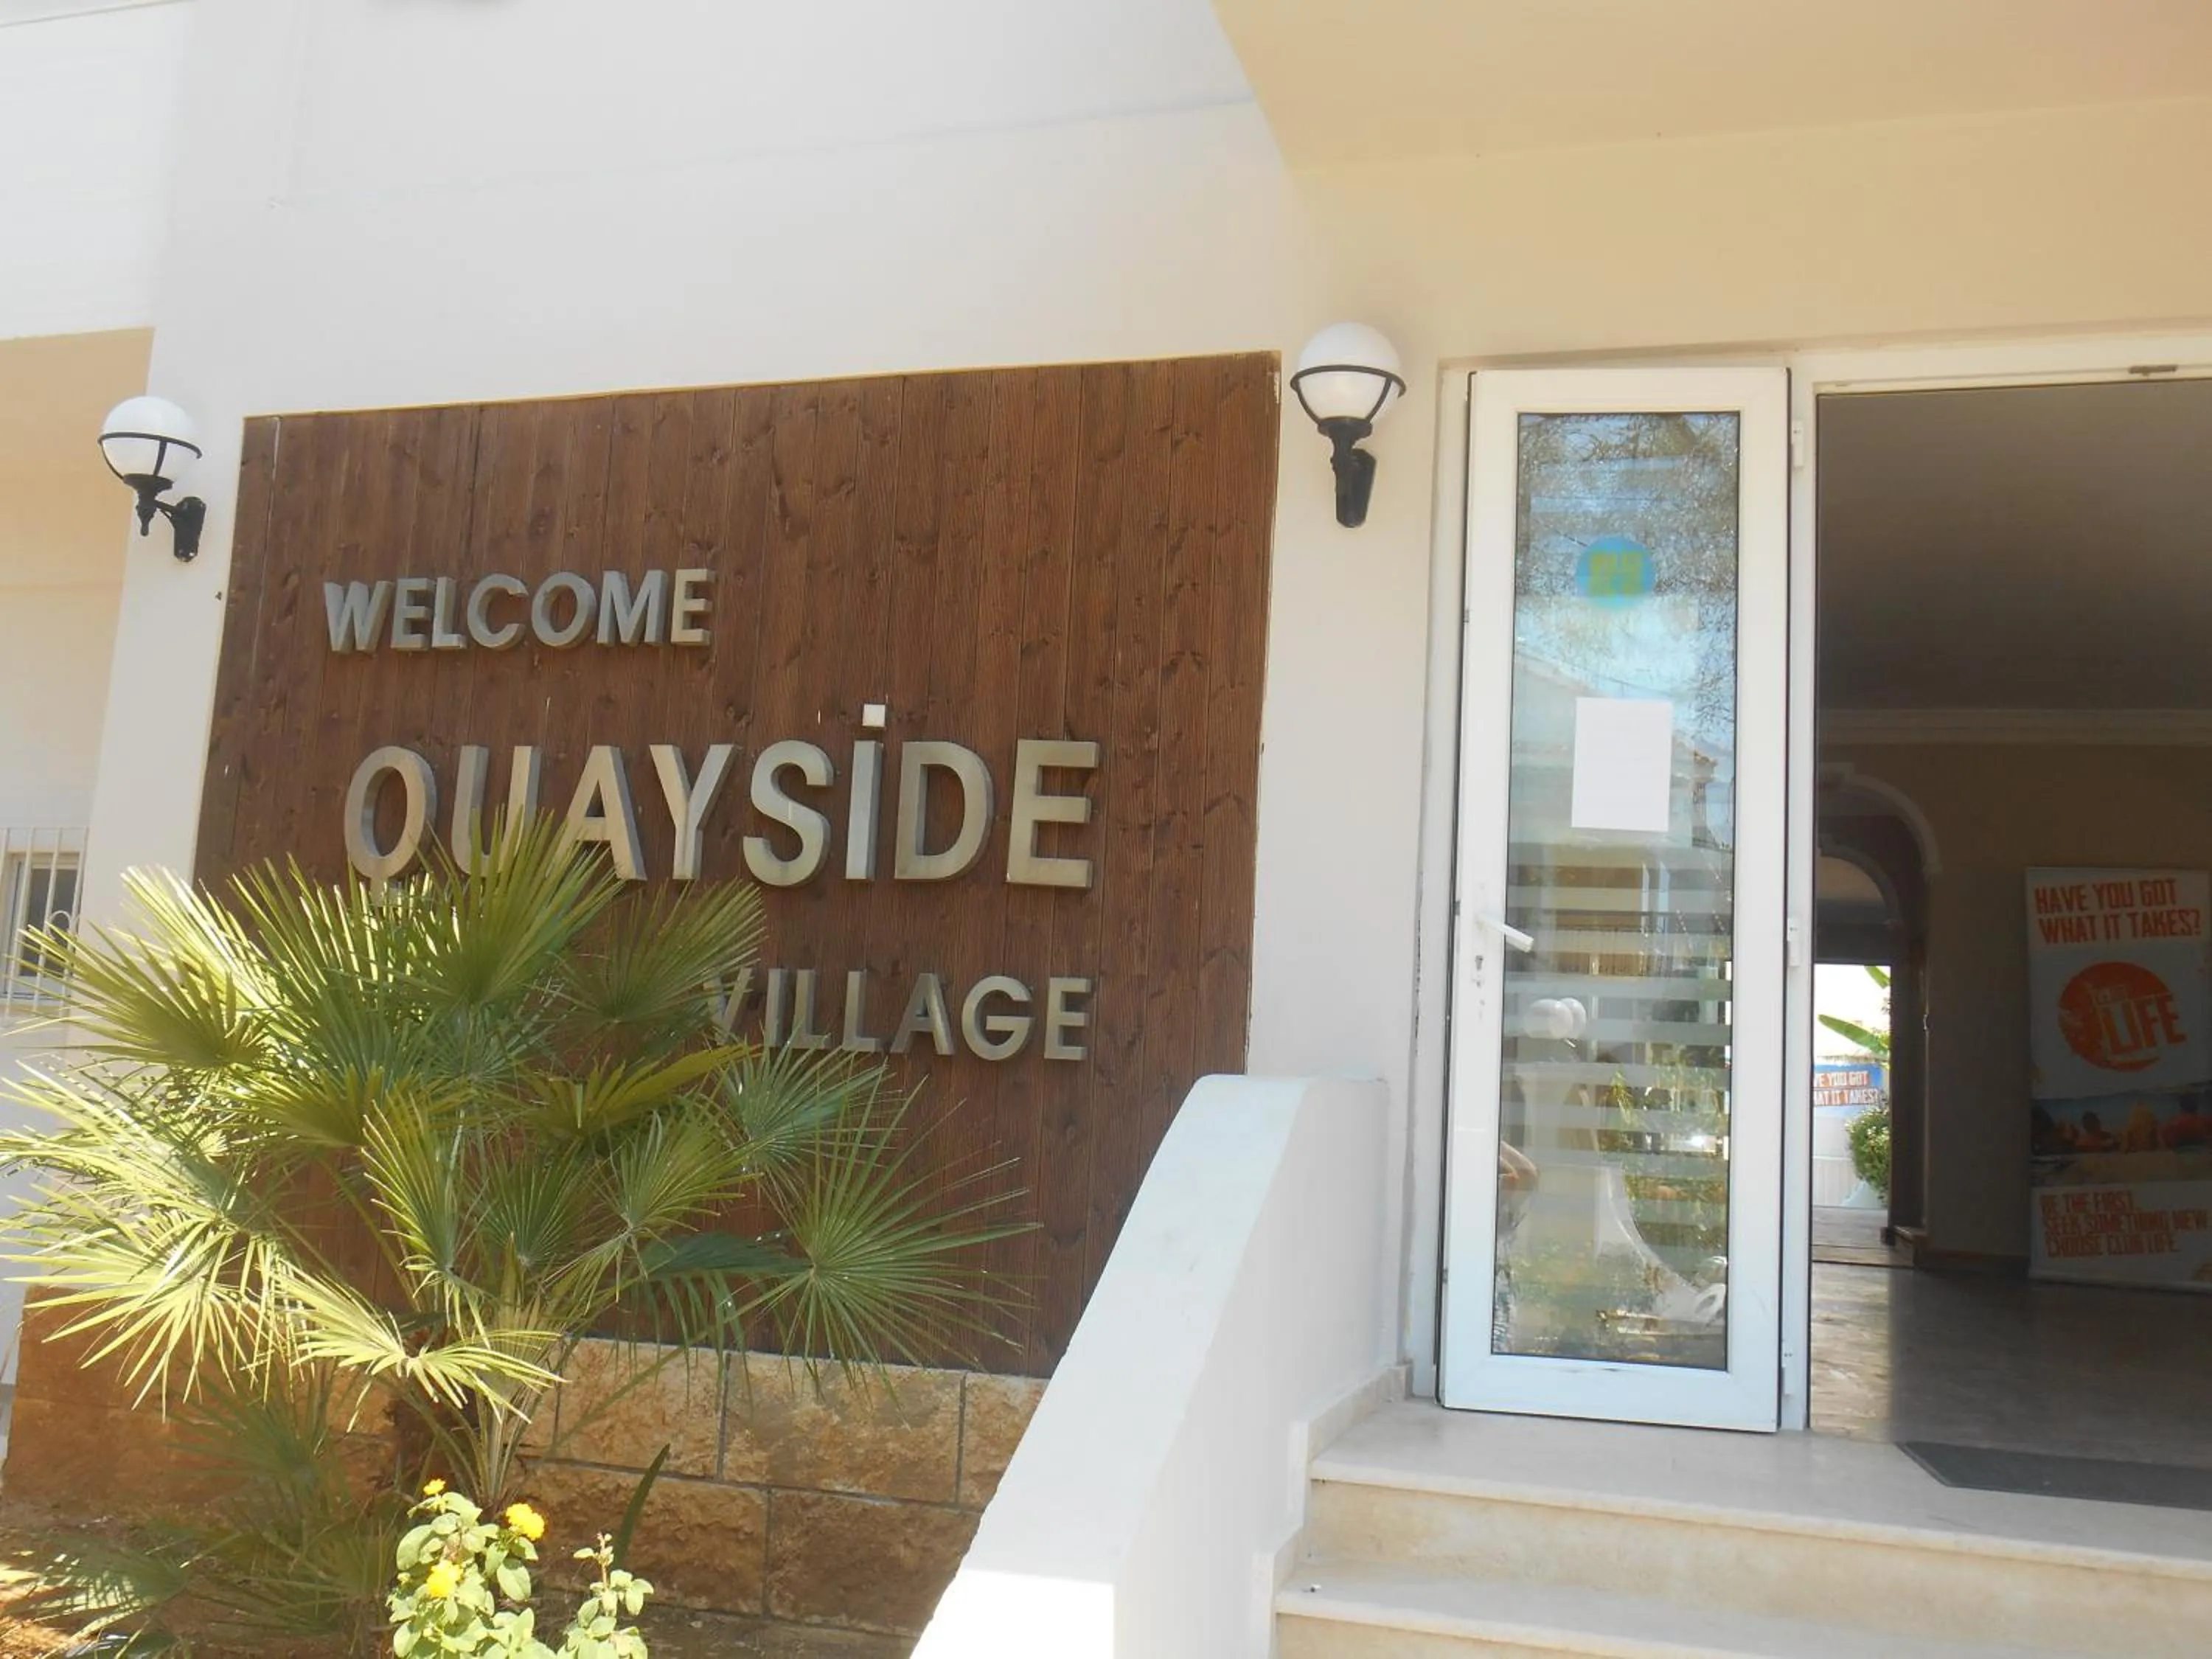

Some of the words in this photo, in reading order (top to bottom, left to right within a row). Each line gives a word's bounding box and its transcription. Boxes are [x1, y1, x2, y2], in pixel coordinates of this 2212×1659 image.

[323, 568, 715, 653] WELCOME
[2034, 885, 2089, 914] HAVE
[2093, 881, 2134, 910] YOU
[2139, 878, 2177, 907] GOT
[2039, 916, 2097, 944] WHAT
[2104, 914, 2120, 940] IT
[2127, 908, 2202, 938] TAKES?
[703, 967, 1092, 1061] VILLAGE
